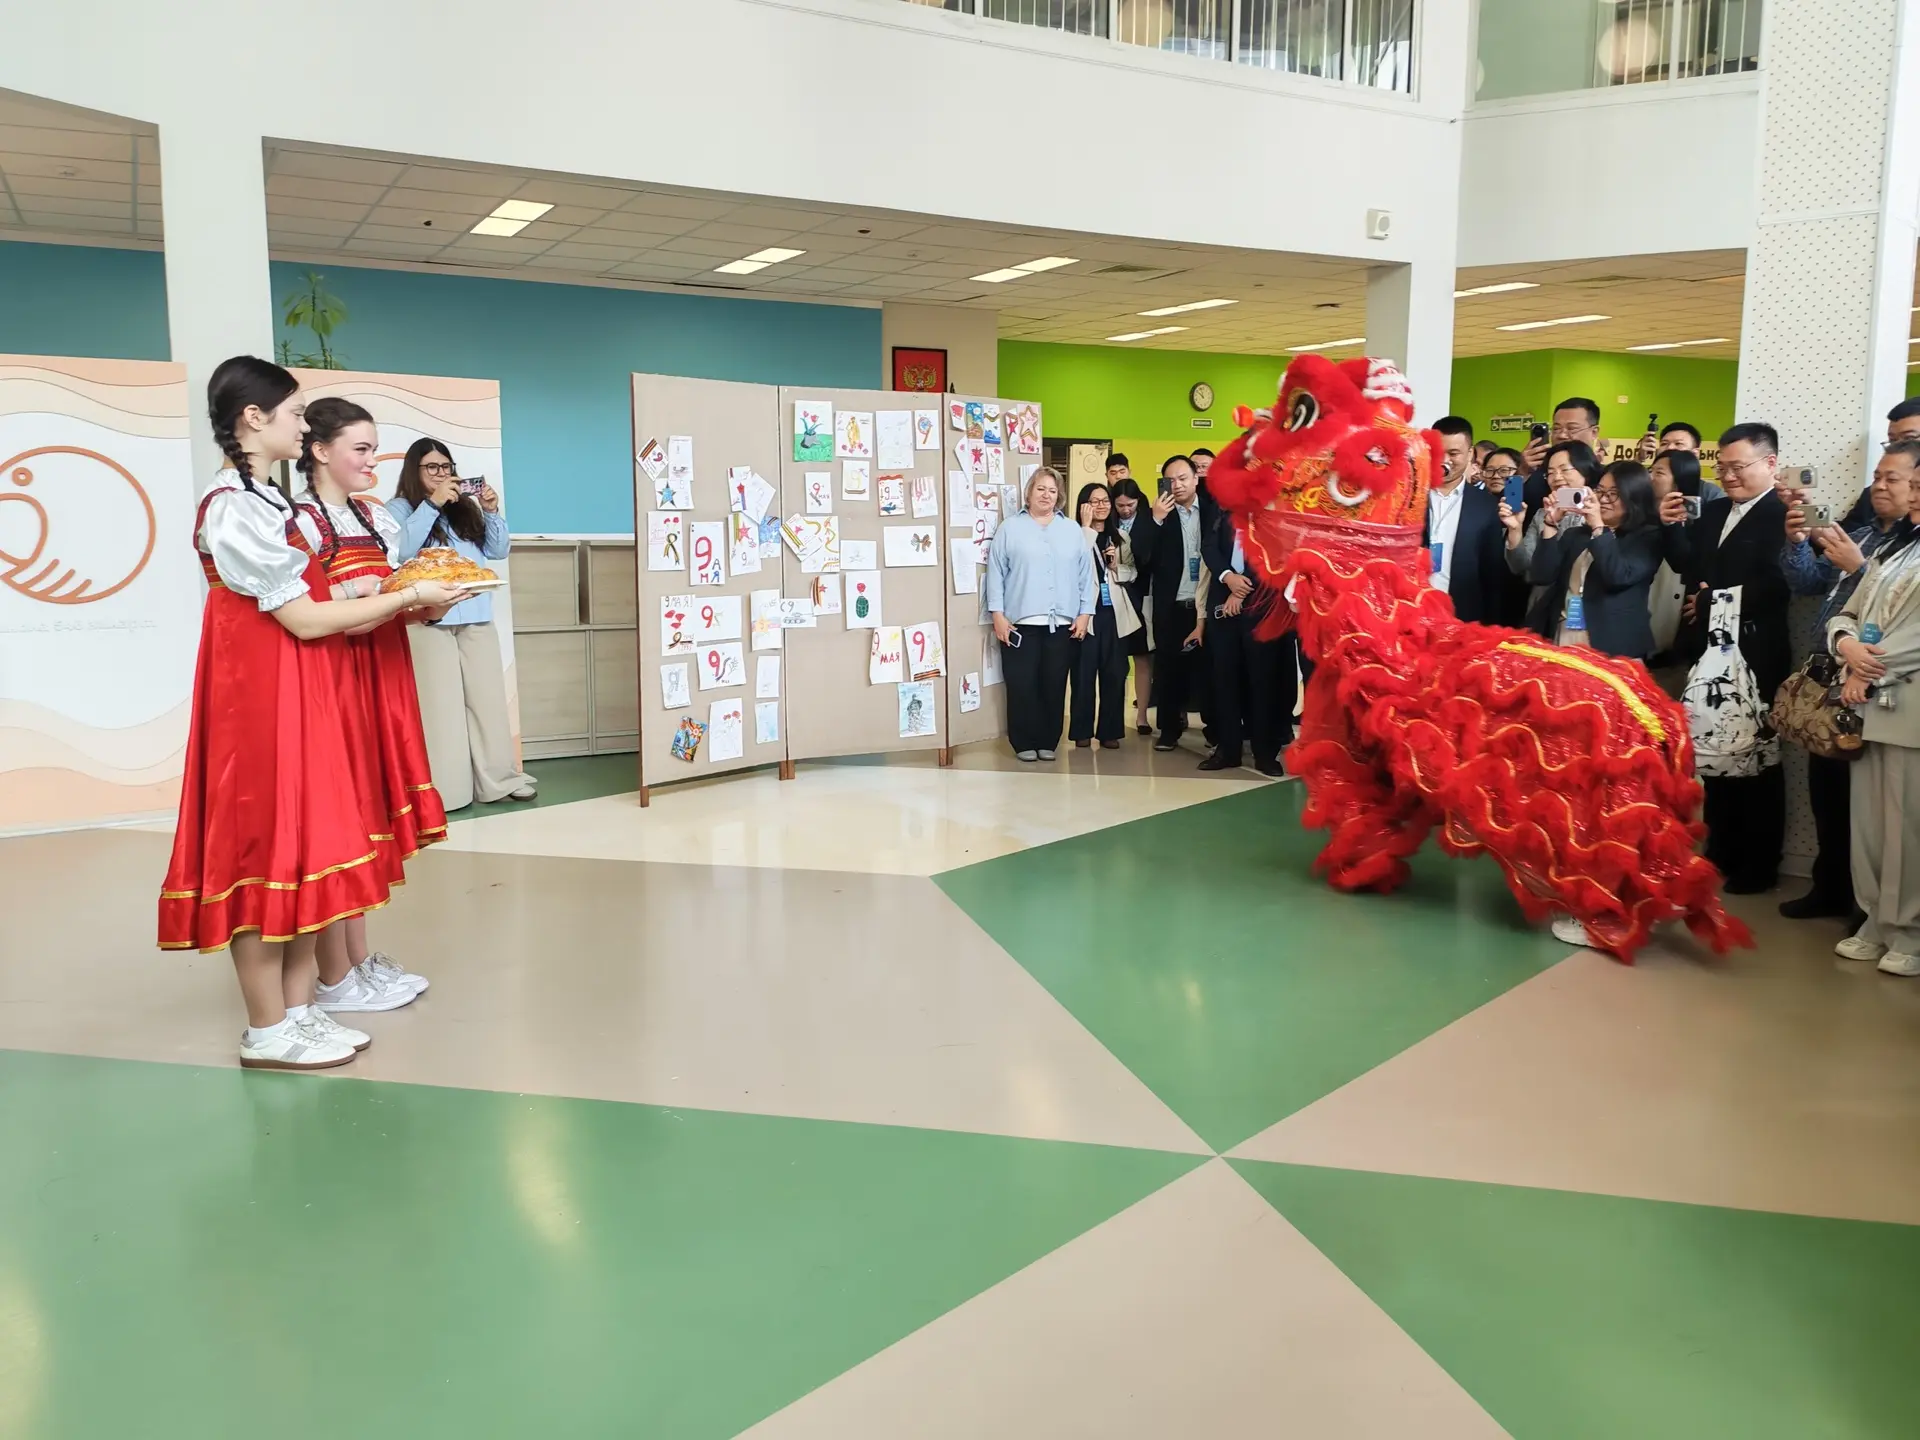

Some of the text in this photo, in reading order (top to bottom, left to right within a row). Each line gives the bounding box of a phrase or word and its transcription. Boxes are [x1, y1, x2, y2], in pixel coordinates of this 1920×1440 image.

[695, 536, 712, 571] 9
[701, 605, 713, 628] 9
[880, 651, 900, 665] МАЯ
[913, 631, 925, 662] 9
[708, 650, 720, 677] 9
